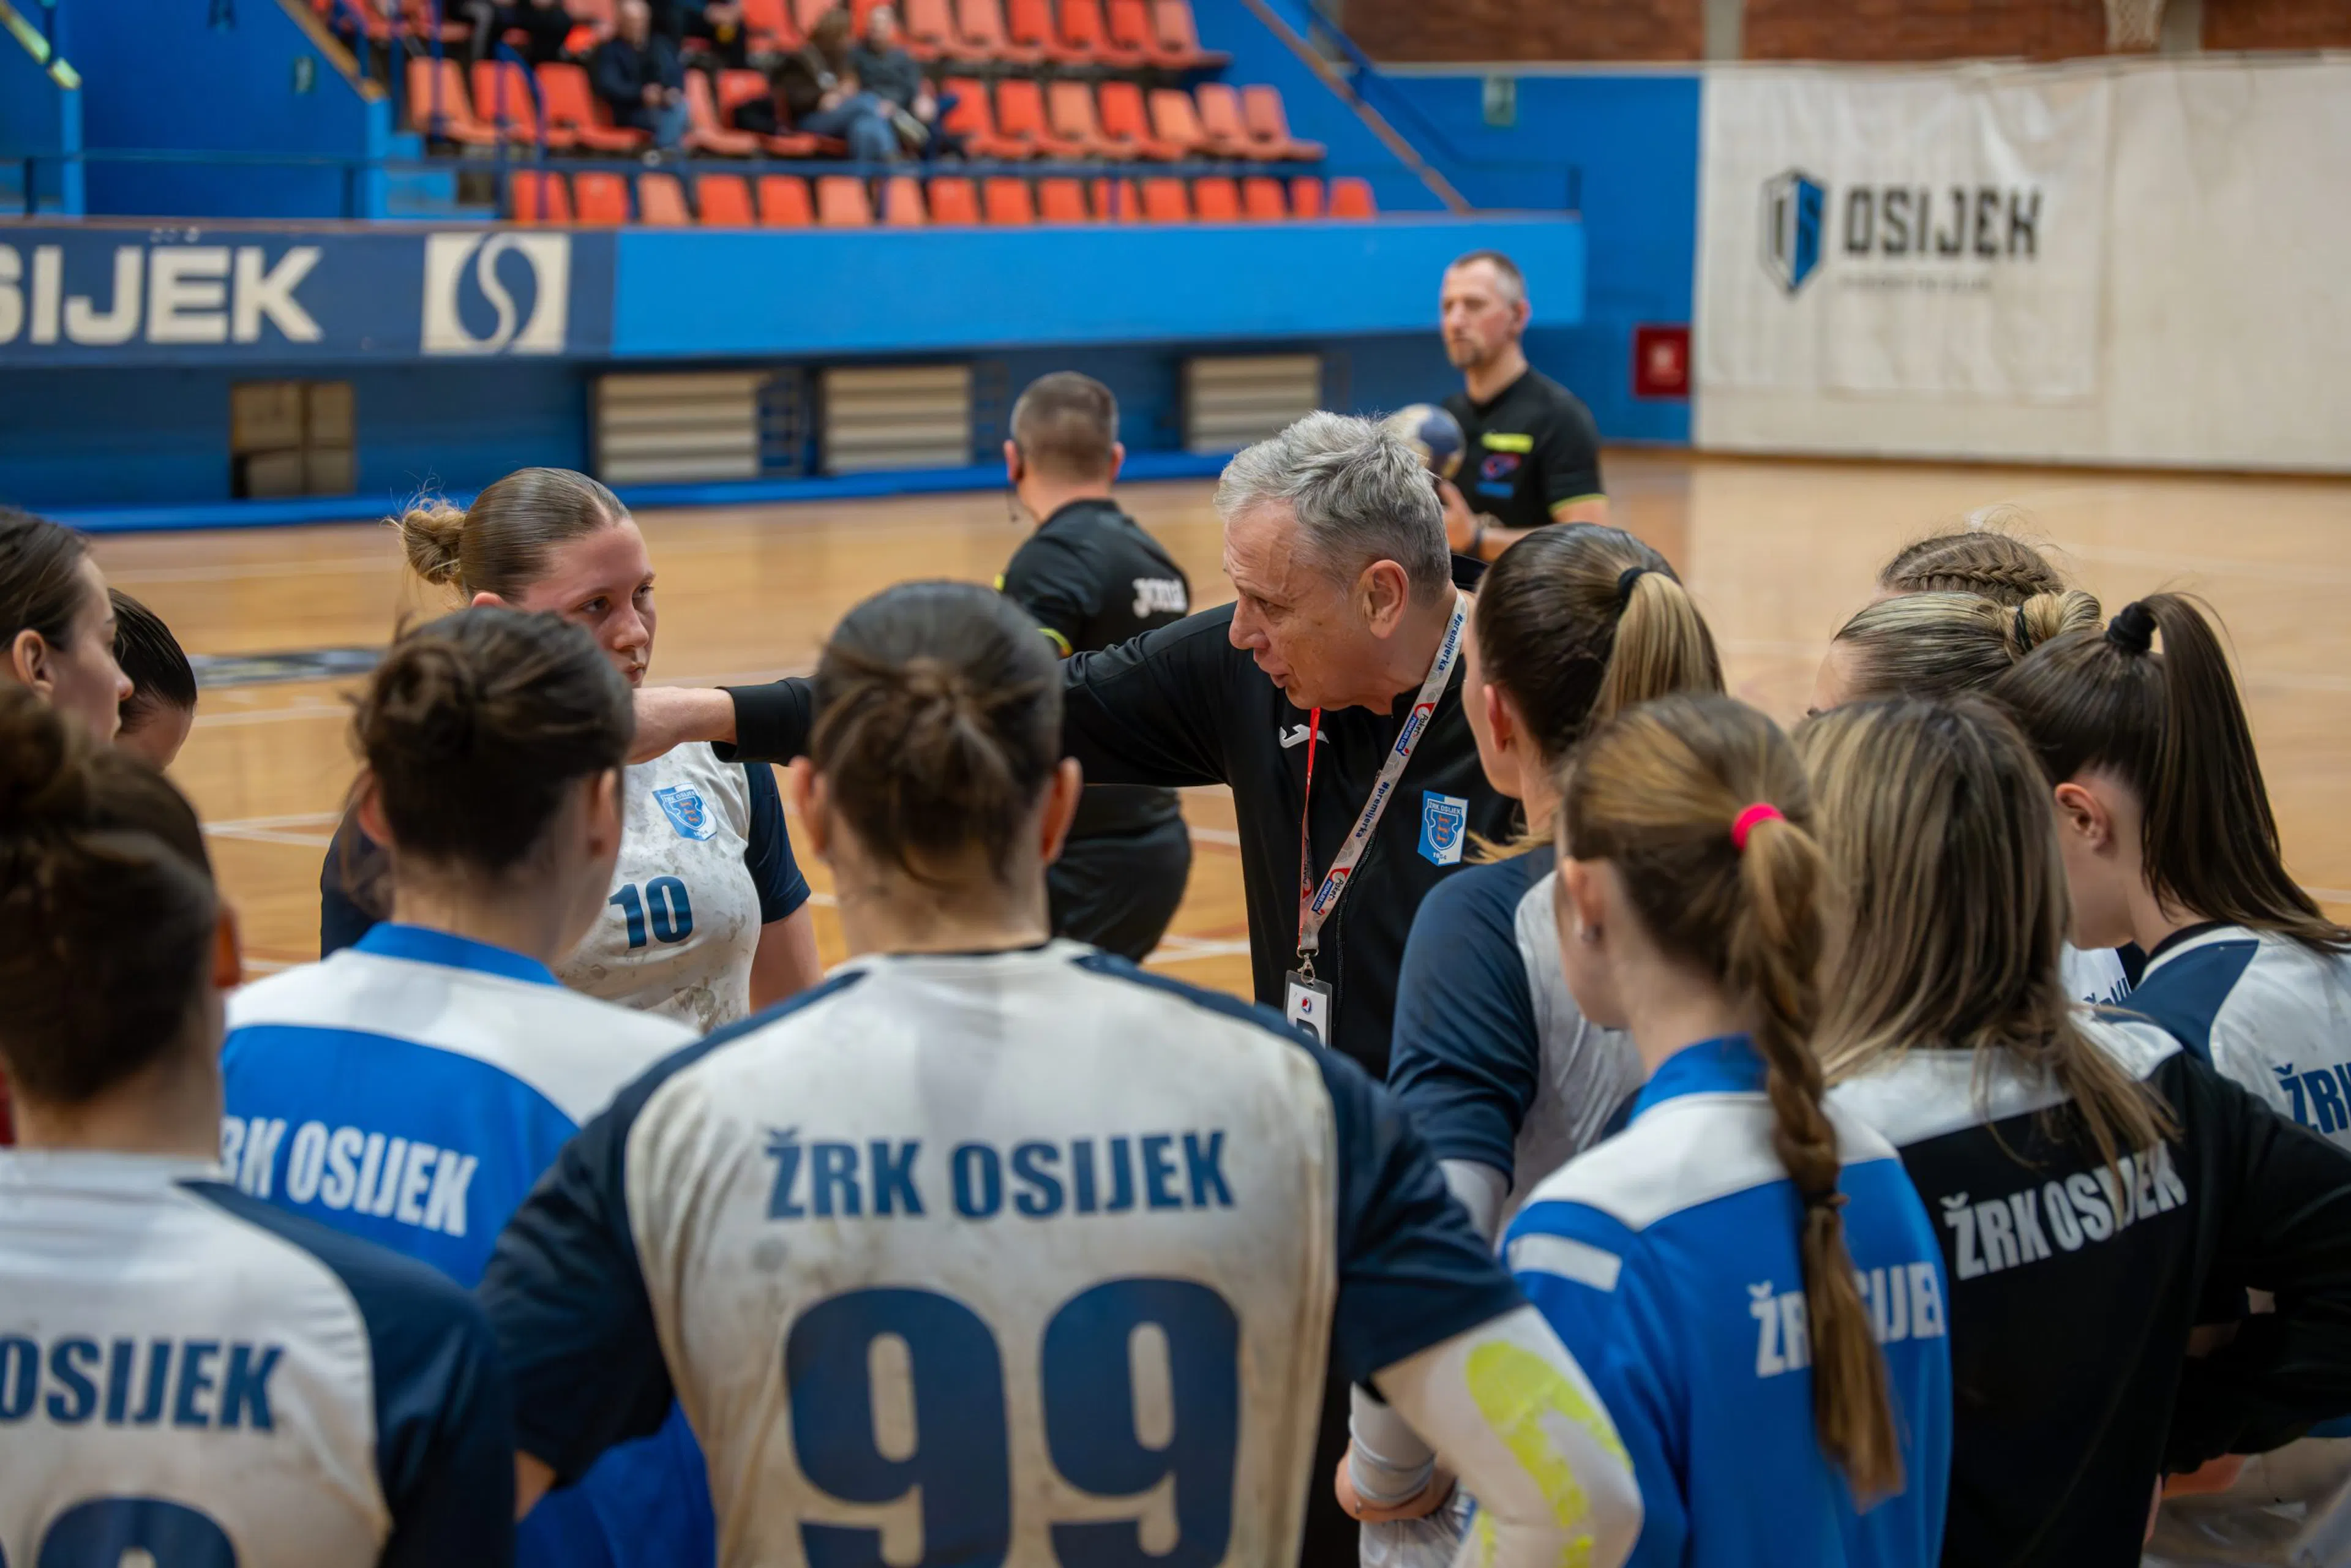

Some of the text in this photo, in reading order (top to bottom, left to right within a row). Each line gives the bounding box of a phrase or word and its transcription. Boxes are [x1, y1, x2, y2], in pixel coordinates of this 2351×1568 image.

[1843, 184, 2043, 258] OSIJEK
[1438, 613, 1463, 671] #premijerka
[1355, 781, 1390, 838] #premijerka
[1441, 805, 1461, 815] OSIJEK
[609, 876, 693, 948] 10
[1329, 878, 1344, 900] Paket
[220, 1115, 479, 1237] RK OSIJEK
[764, 1127, 1236, 1219] ŽRK OSIJEK
[1940, 1191, 2052, 1280] ŽRK
[1747, 1279, 1810, 1378] ŽR
[0, 1334, 286, 1435] OSIJEK
[785, 1277, 1240, 1568] 99
